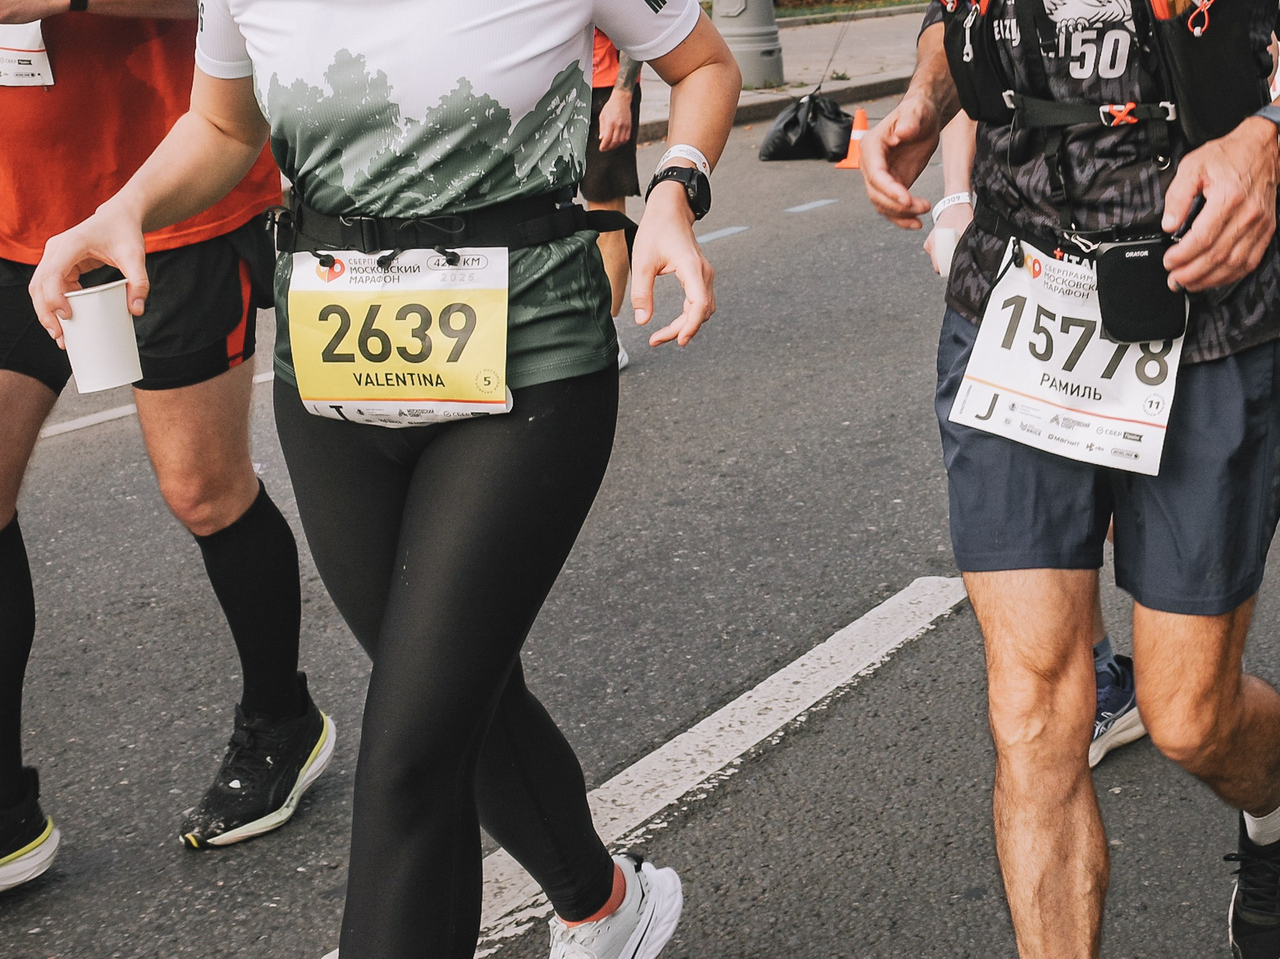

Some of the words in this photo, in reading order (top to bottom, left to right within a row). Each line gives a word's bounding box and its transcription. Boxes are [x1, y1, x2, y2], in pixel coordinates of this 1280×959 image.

[348, 274, 400, 285] МАРАФОН
[1043, 272, 1098, 292] МОСКОВСК
[1044, 263, 1094, 283] СБЕРПРАЙМ
[1043, 280, 1090, 300] МАРАФОН
[318, 302, 477, 363] 2639
[1000, 294, 1174, 386] 15778
[352, 372, 446, 388] VALENTINA
[483, 376, 492, 386] 5
[1039, 372, 1103, 402] РАМИЛЬ
[974, 393, 1000, 421] J
[1147, 399, 1161, 410] 11
